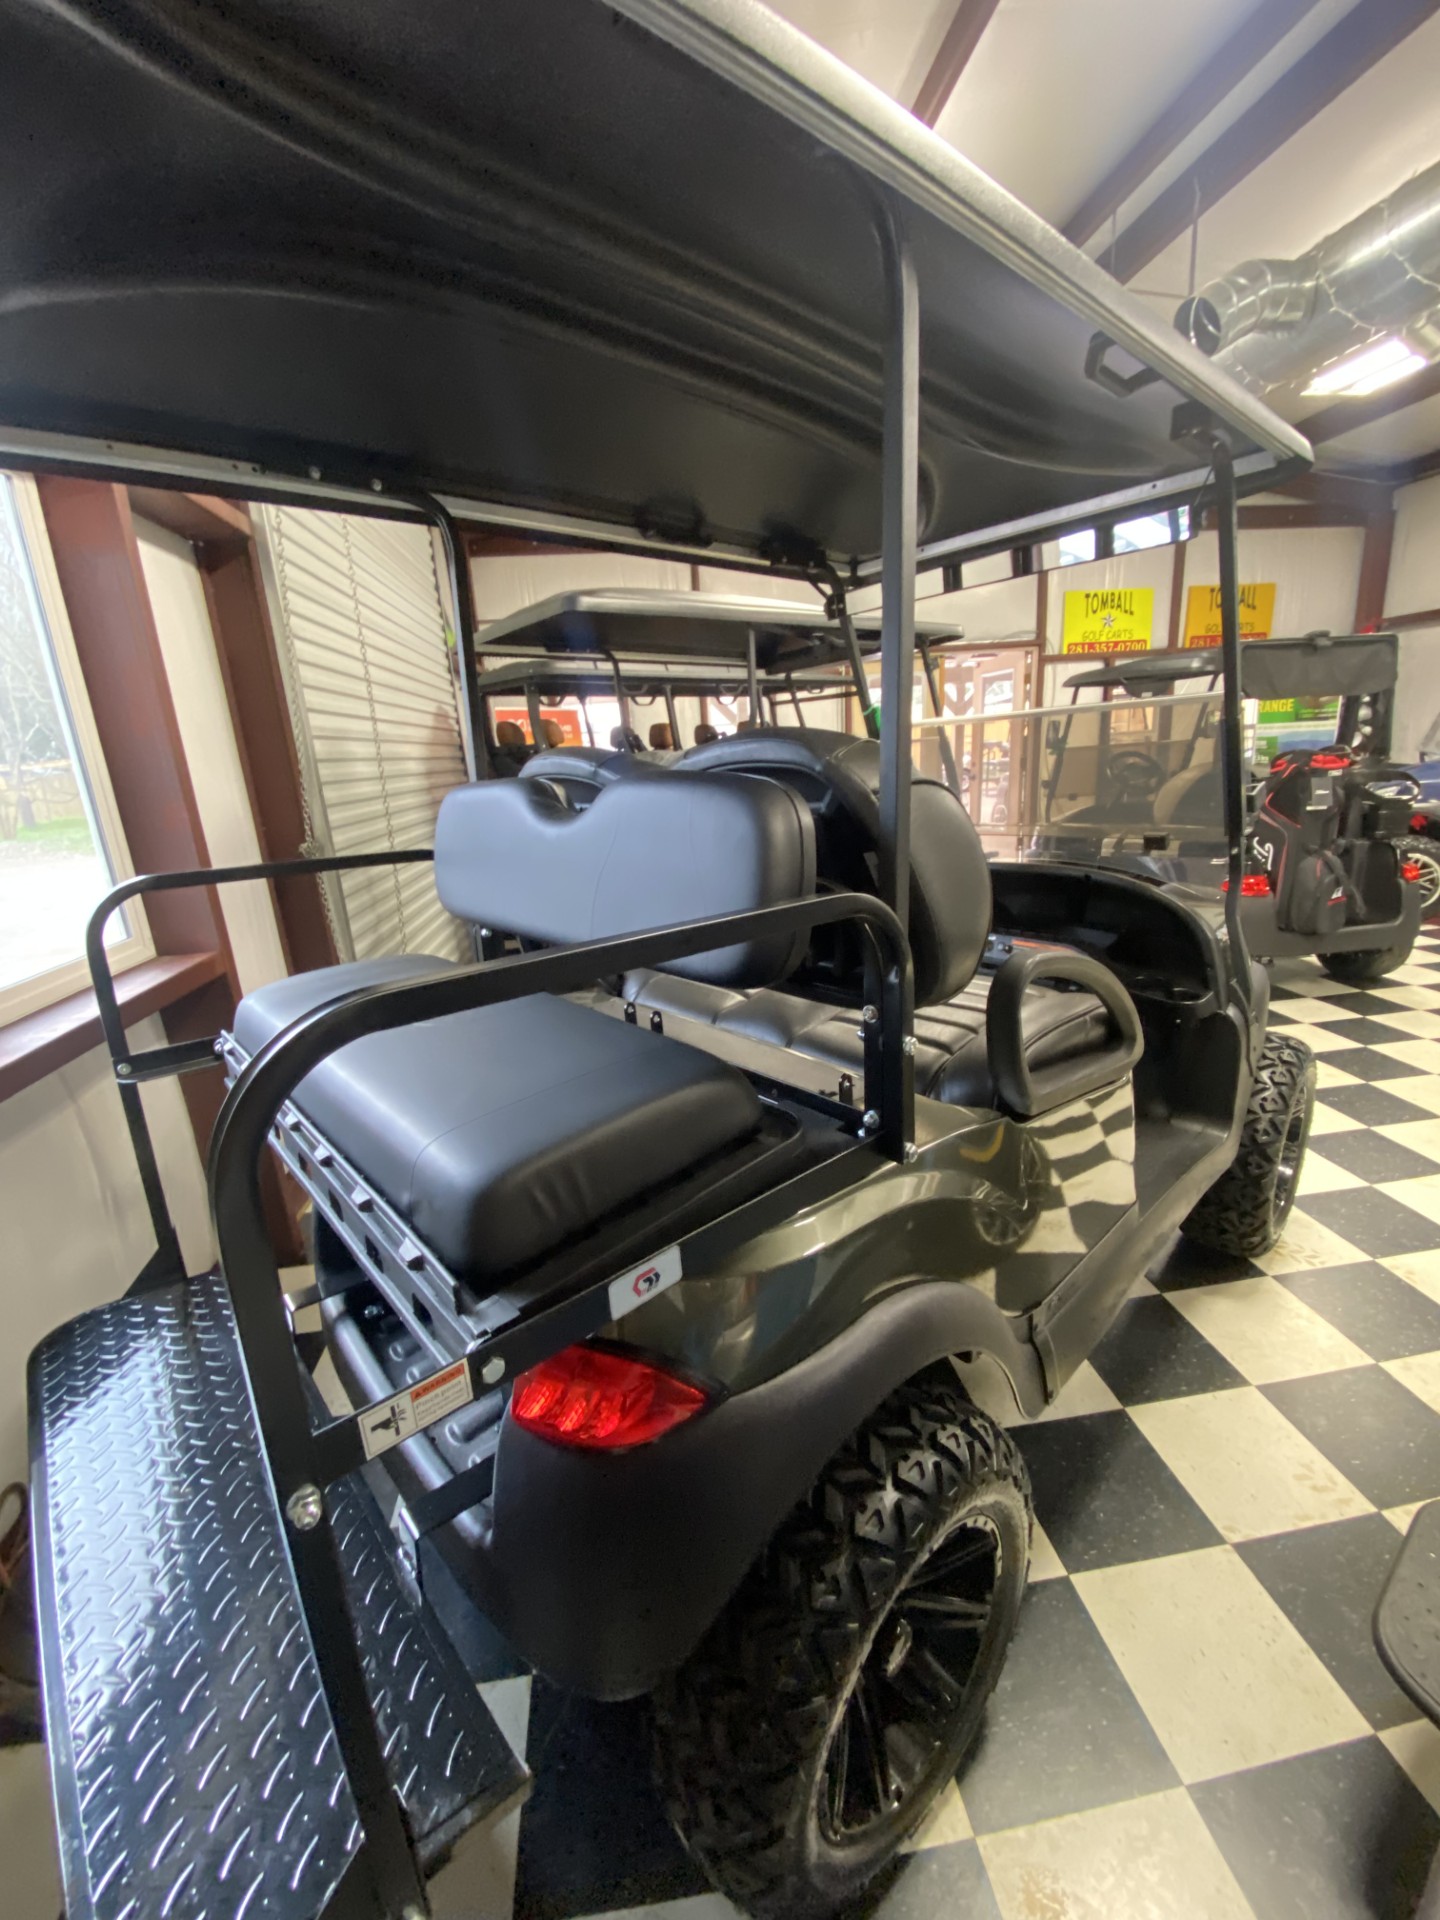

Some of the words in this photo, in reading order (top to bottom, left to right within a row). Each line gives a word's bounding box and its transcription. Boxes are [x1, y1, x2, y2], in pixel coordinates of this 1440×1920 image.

[1084, 591, 1134, 618] TOMBALL
[1209, 585, 1257, 612] TOALL
[1082, 630, 1104, 642] GOLF
[1105, 628, 1134, 640] CARTS
[1068, 641, 1146, 654] 281-357-0700
